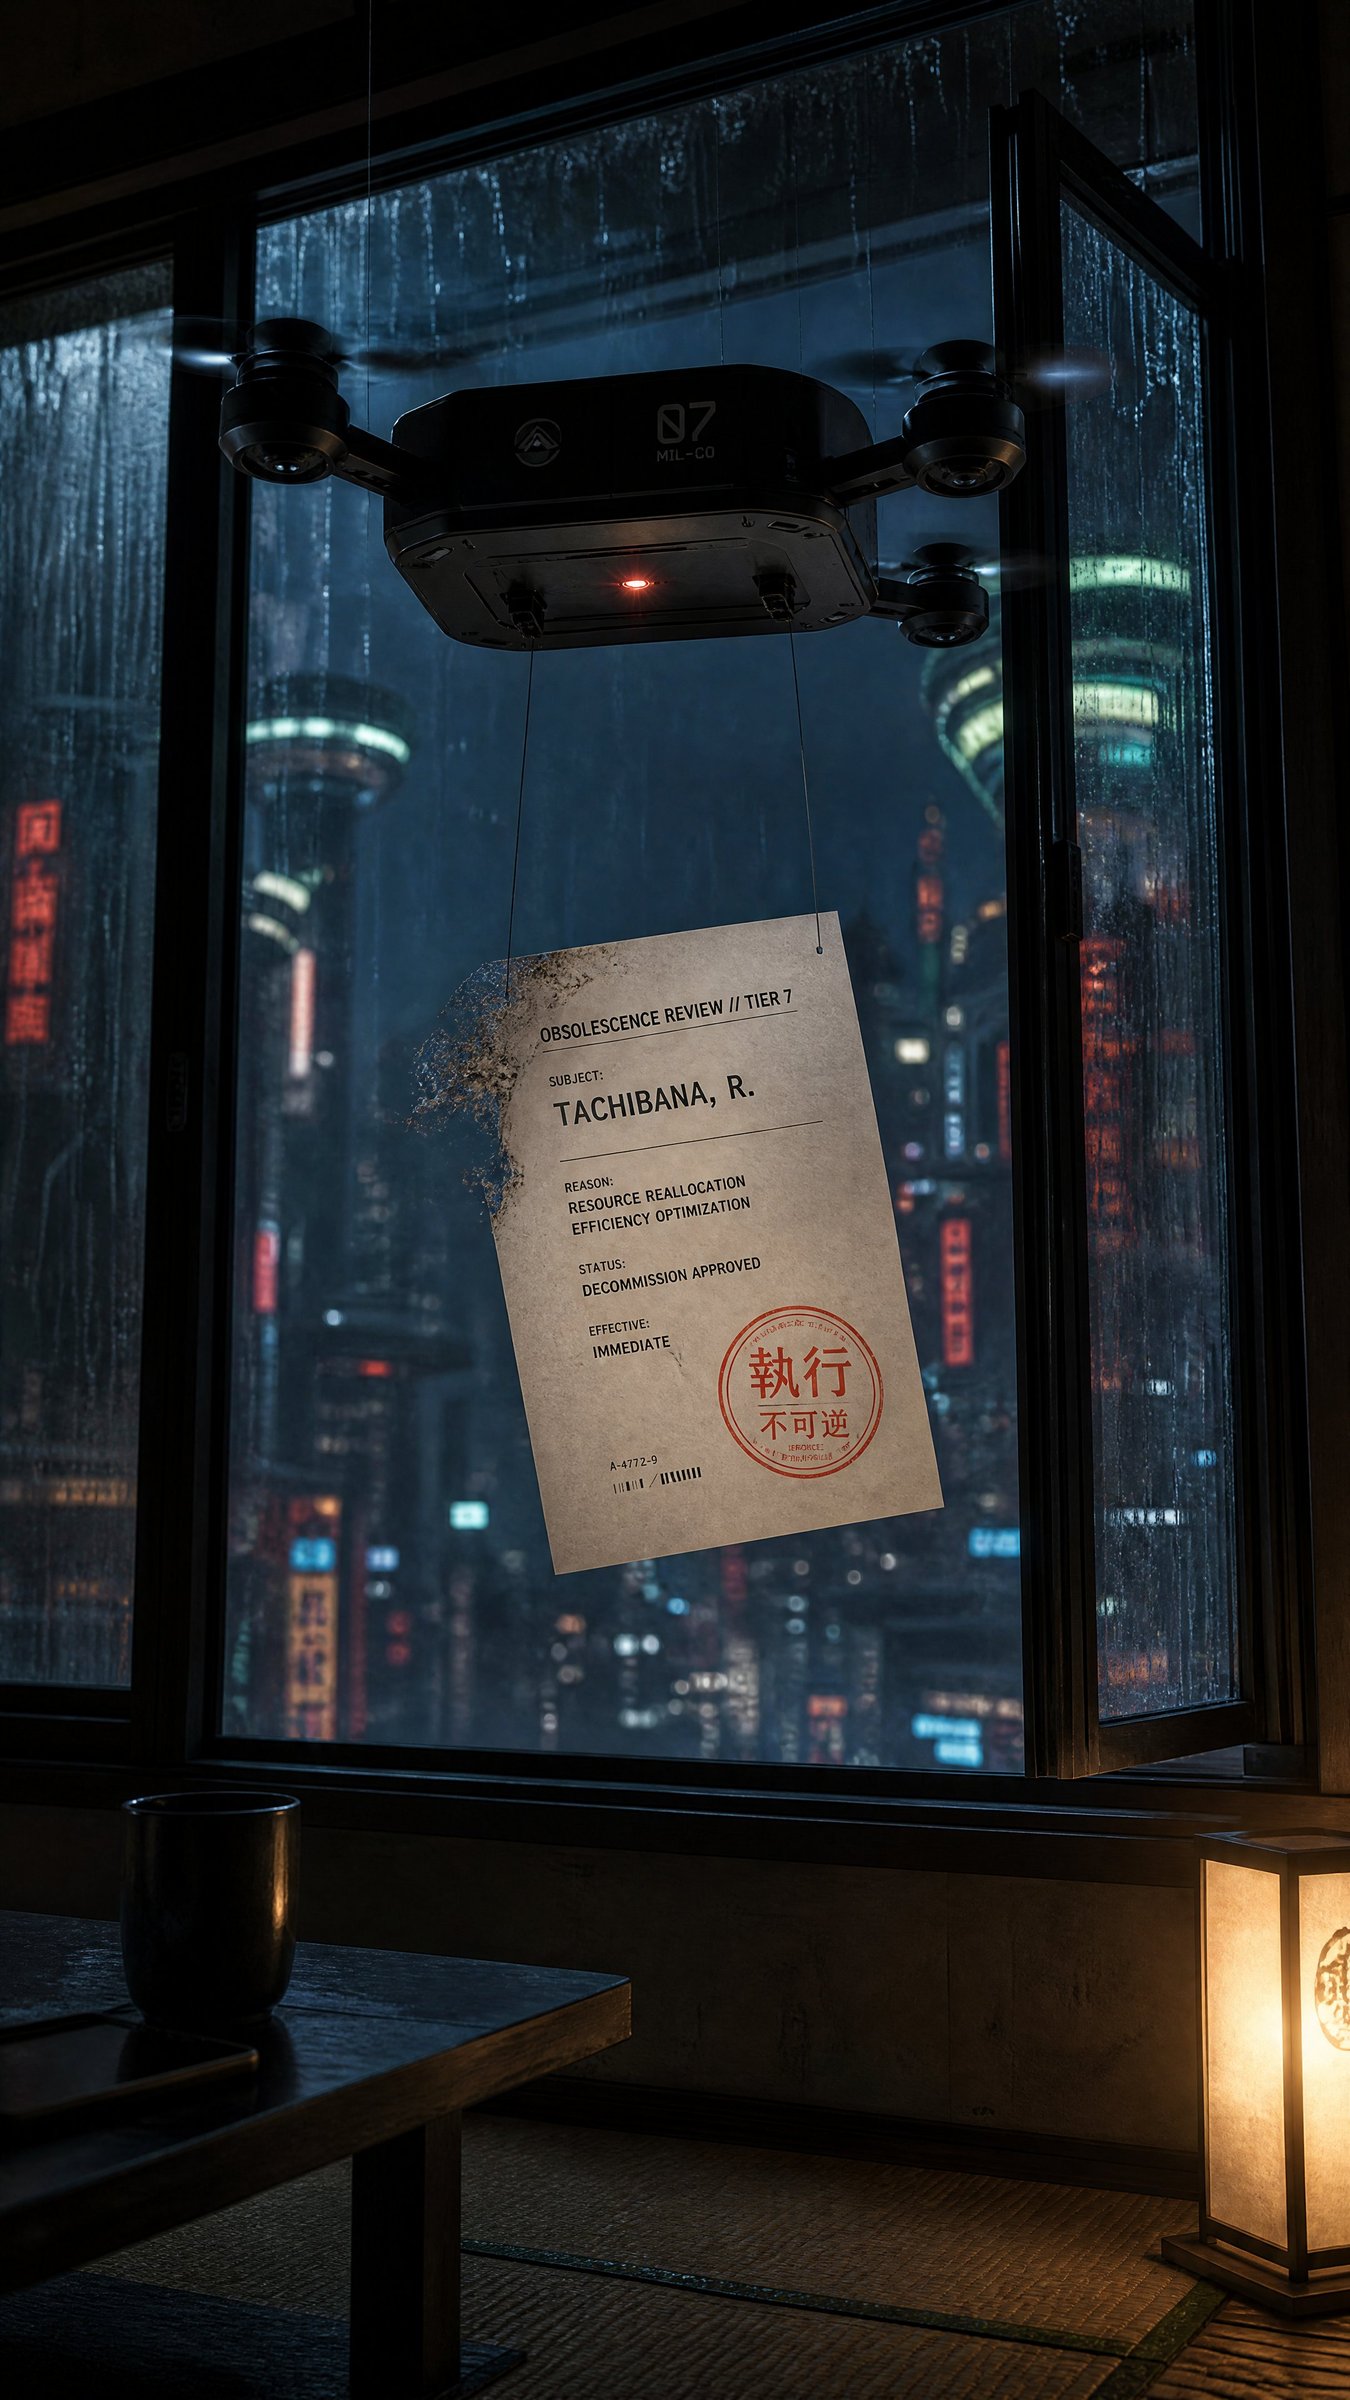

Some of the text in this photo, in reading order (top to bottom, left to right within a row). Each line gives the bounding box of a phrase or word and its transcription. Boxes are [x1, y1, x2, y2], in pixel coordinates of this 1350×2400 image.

[657, 401, 716, 444] 07
[657, 446, 716, 462] MIL-CO
[540, 989, 792, 1043] OBSOLESCENCE REVIEW // TIER 7
[549, 1070, 604, 1088] SUBJECT:
[553, 1075, 755, 1127] TACHIBANA, R.
[565, 1177, 614, 1194] REASON:
[568, 1175, 746, 1215] RESOURCE REALLOCATION
[572, 1196, 751, 1236] EFFICIENCY OPTIMIZATION
[579, 1259, 626, 1275] STATUS:
[582, 1257, 761, 1298] DECOMMISSION APPROVED
[589, 1319, 651, 1337] EFFECTIVE:
[593, 1335, 671, 1359] IMMEDIATE
[748, 1345, 852, 1399] 執行
[759, 1408, 850, 1441] 不可逆
[610, 1455, 658, 1472] A-4772-9
